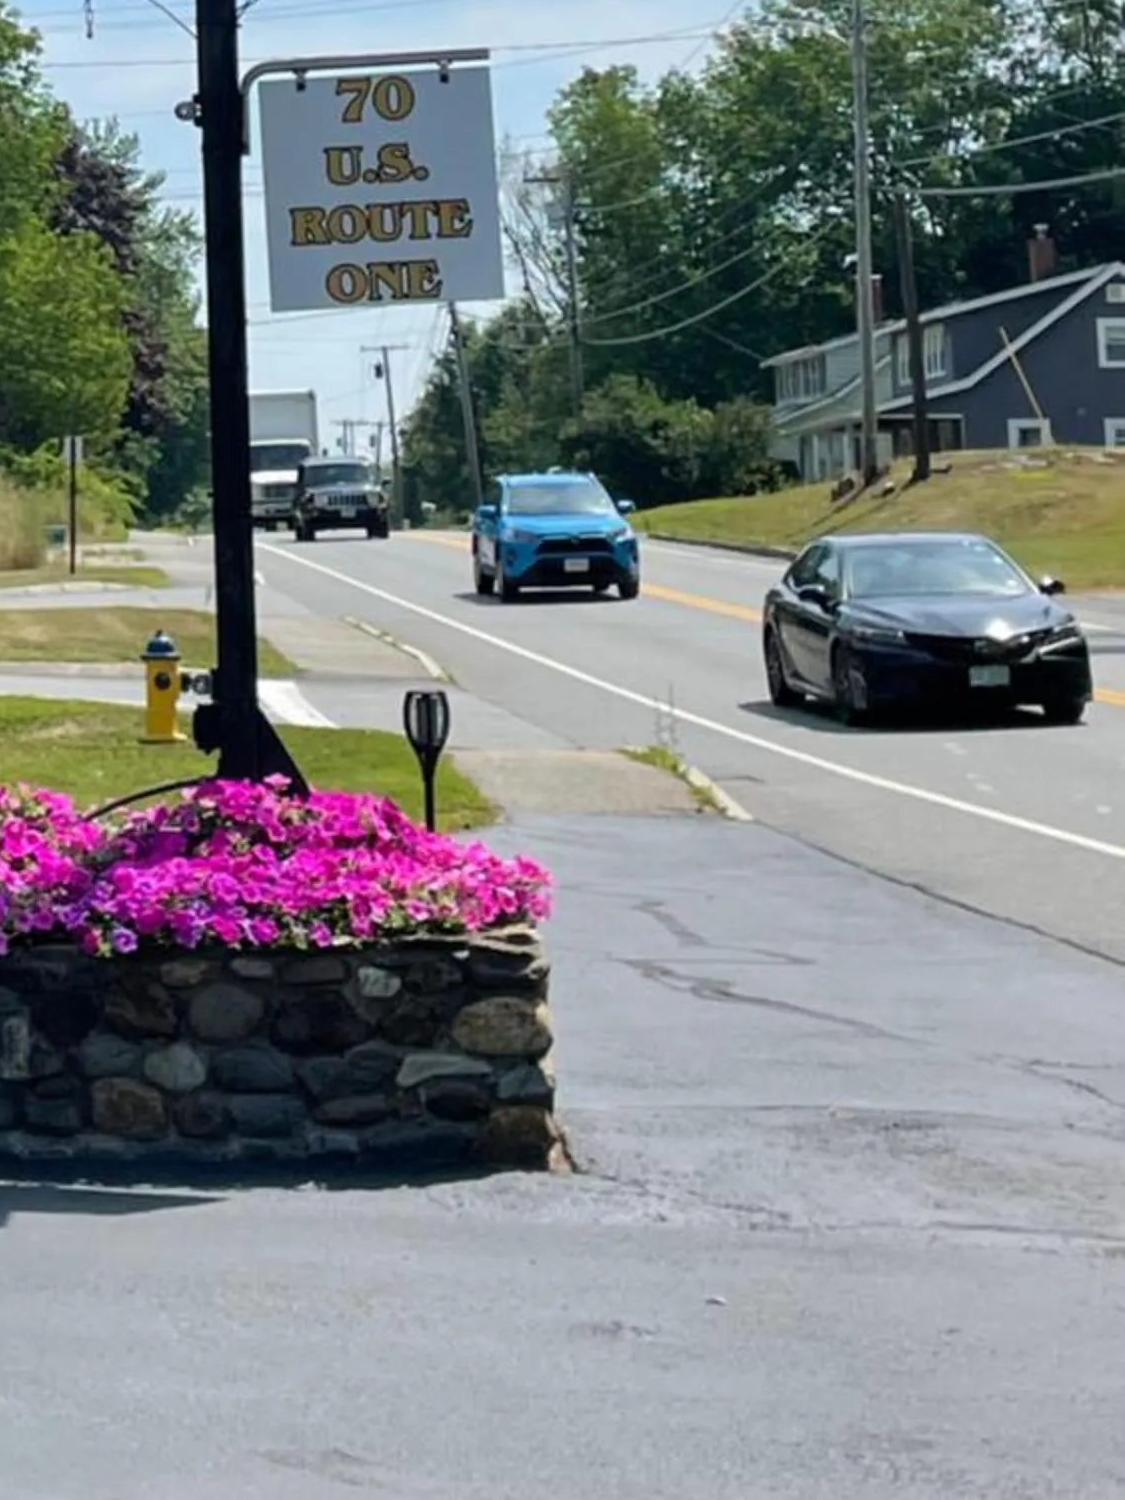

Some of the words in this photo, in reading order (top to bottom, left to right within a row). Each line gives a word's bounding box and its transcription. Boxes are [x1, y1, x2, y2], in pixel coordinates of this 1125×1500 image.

[335, 75, 415, 123] 70
[323, 142, 429, 186] U.S.
[289, 198, 473, 246] ROUTE
[325, 258, 443, 304] ONE
